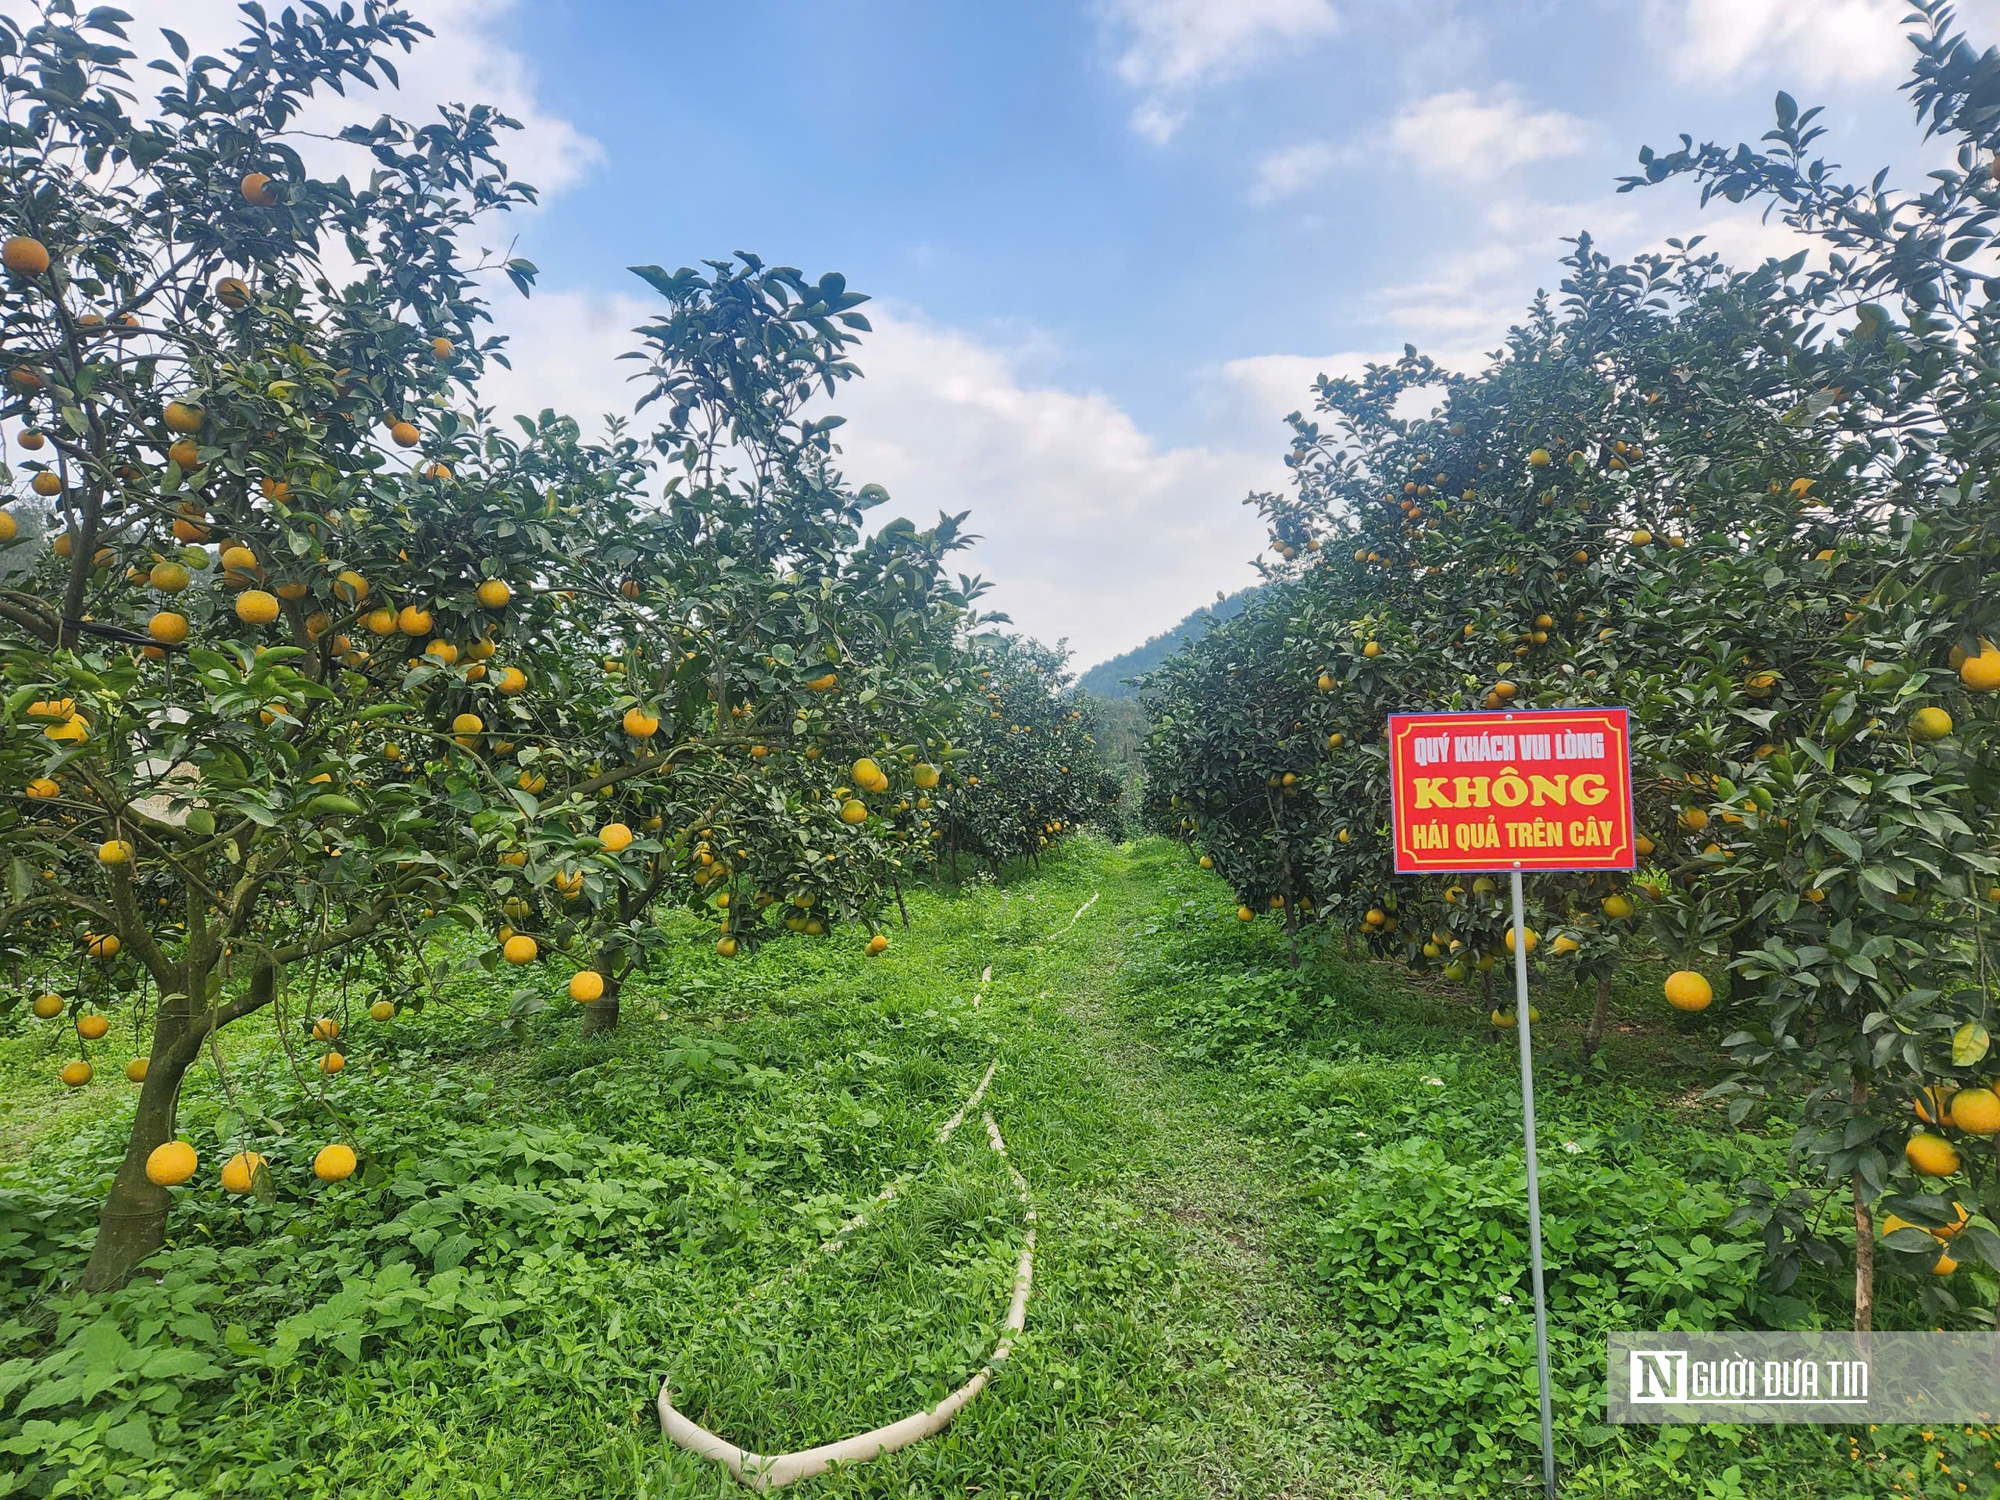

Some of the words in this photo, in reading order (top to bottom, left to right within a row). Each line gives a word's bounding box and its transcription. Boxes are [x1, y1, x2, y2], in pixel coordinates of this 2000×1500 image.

[1414, 732, 1450, 766] QUÝ
[1454, 731, 1515, 763] KHÁCH
[1519, 734, 1551, 760] VUI
[1555, 729, 1604, 760] LÒNG
[1412, 766, 1609, 809] KHÔNG
[1412, 819, 1449, 849] HÁI
[1455, 814, 1500, 851] QUẢ
[1505, 817, 1563, 848] TRÊN
[1569, 815, 1613, 846] CÂY
